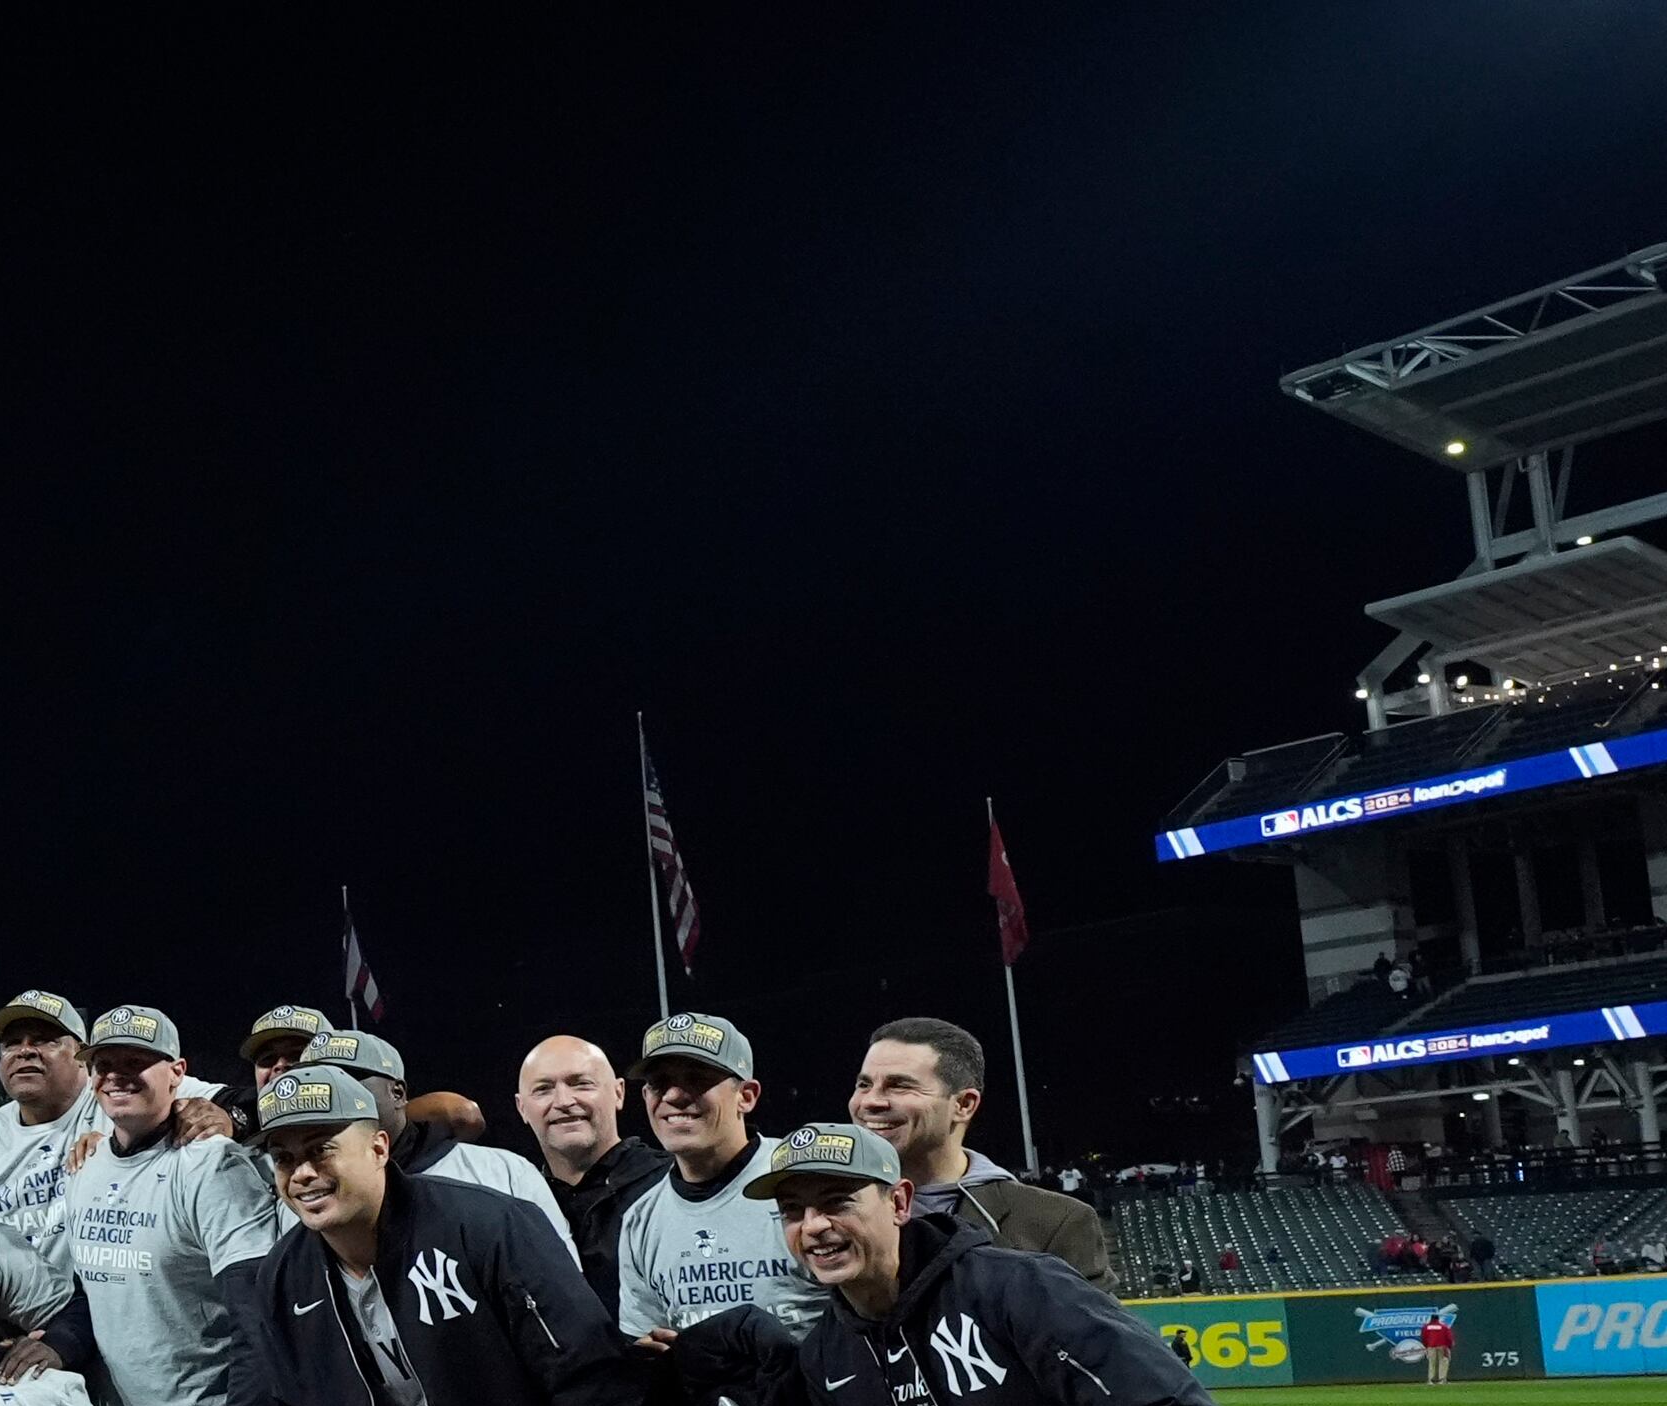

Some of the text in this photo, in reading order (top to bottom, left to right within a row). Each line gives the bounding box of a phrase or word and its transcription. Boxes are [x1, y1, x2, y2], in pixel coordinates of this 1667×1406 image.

[1300, 798, 1364, 829] ALCS
[1413, 769, 1507, 803] loanDepot
[1372, 1039, 1427, 1063] ALCS
[1470, 1024, 1550, 1048] loanDepot
[83, 1208, 157, 1229] AMERICAN
[79, 1225, 133, 1246] LEAGUE
[677, 1256, 790, 1285] AMERICAN
[676, 1280, 757, 1304] LEAGUE
[1480, 1351, 1520, 1368] 375
